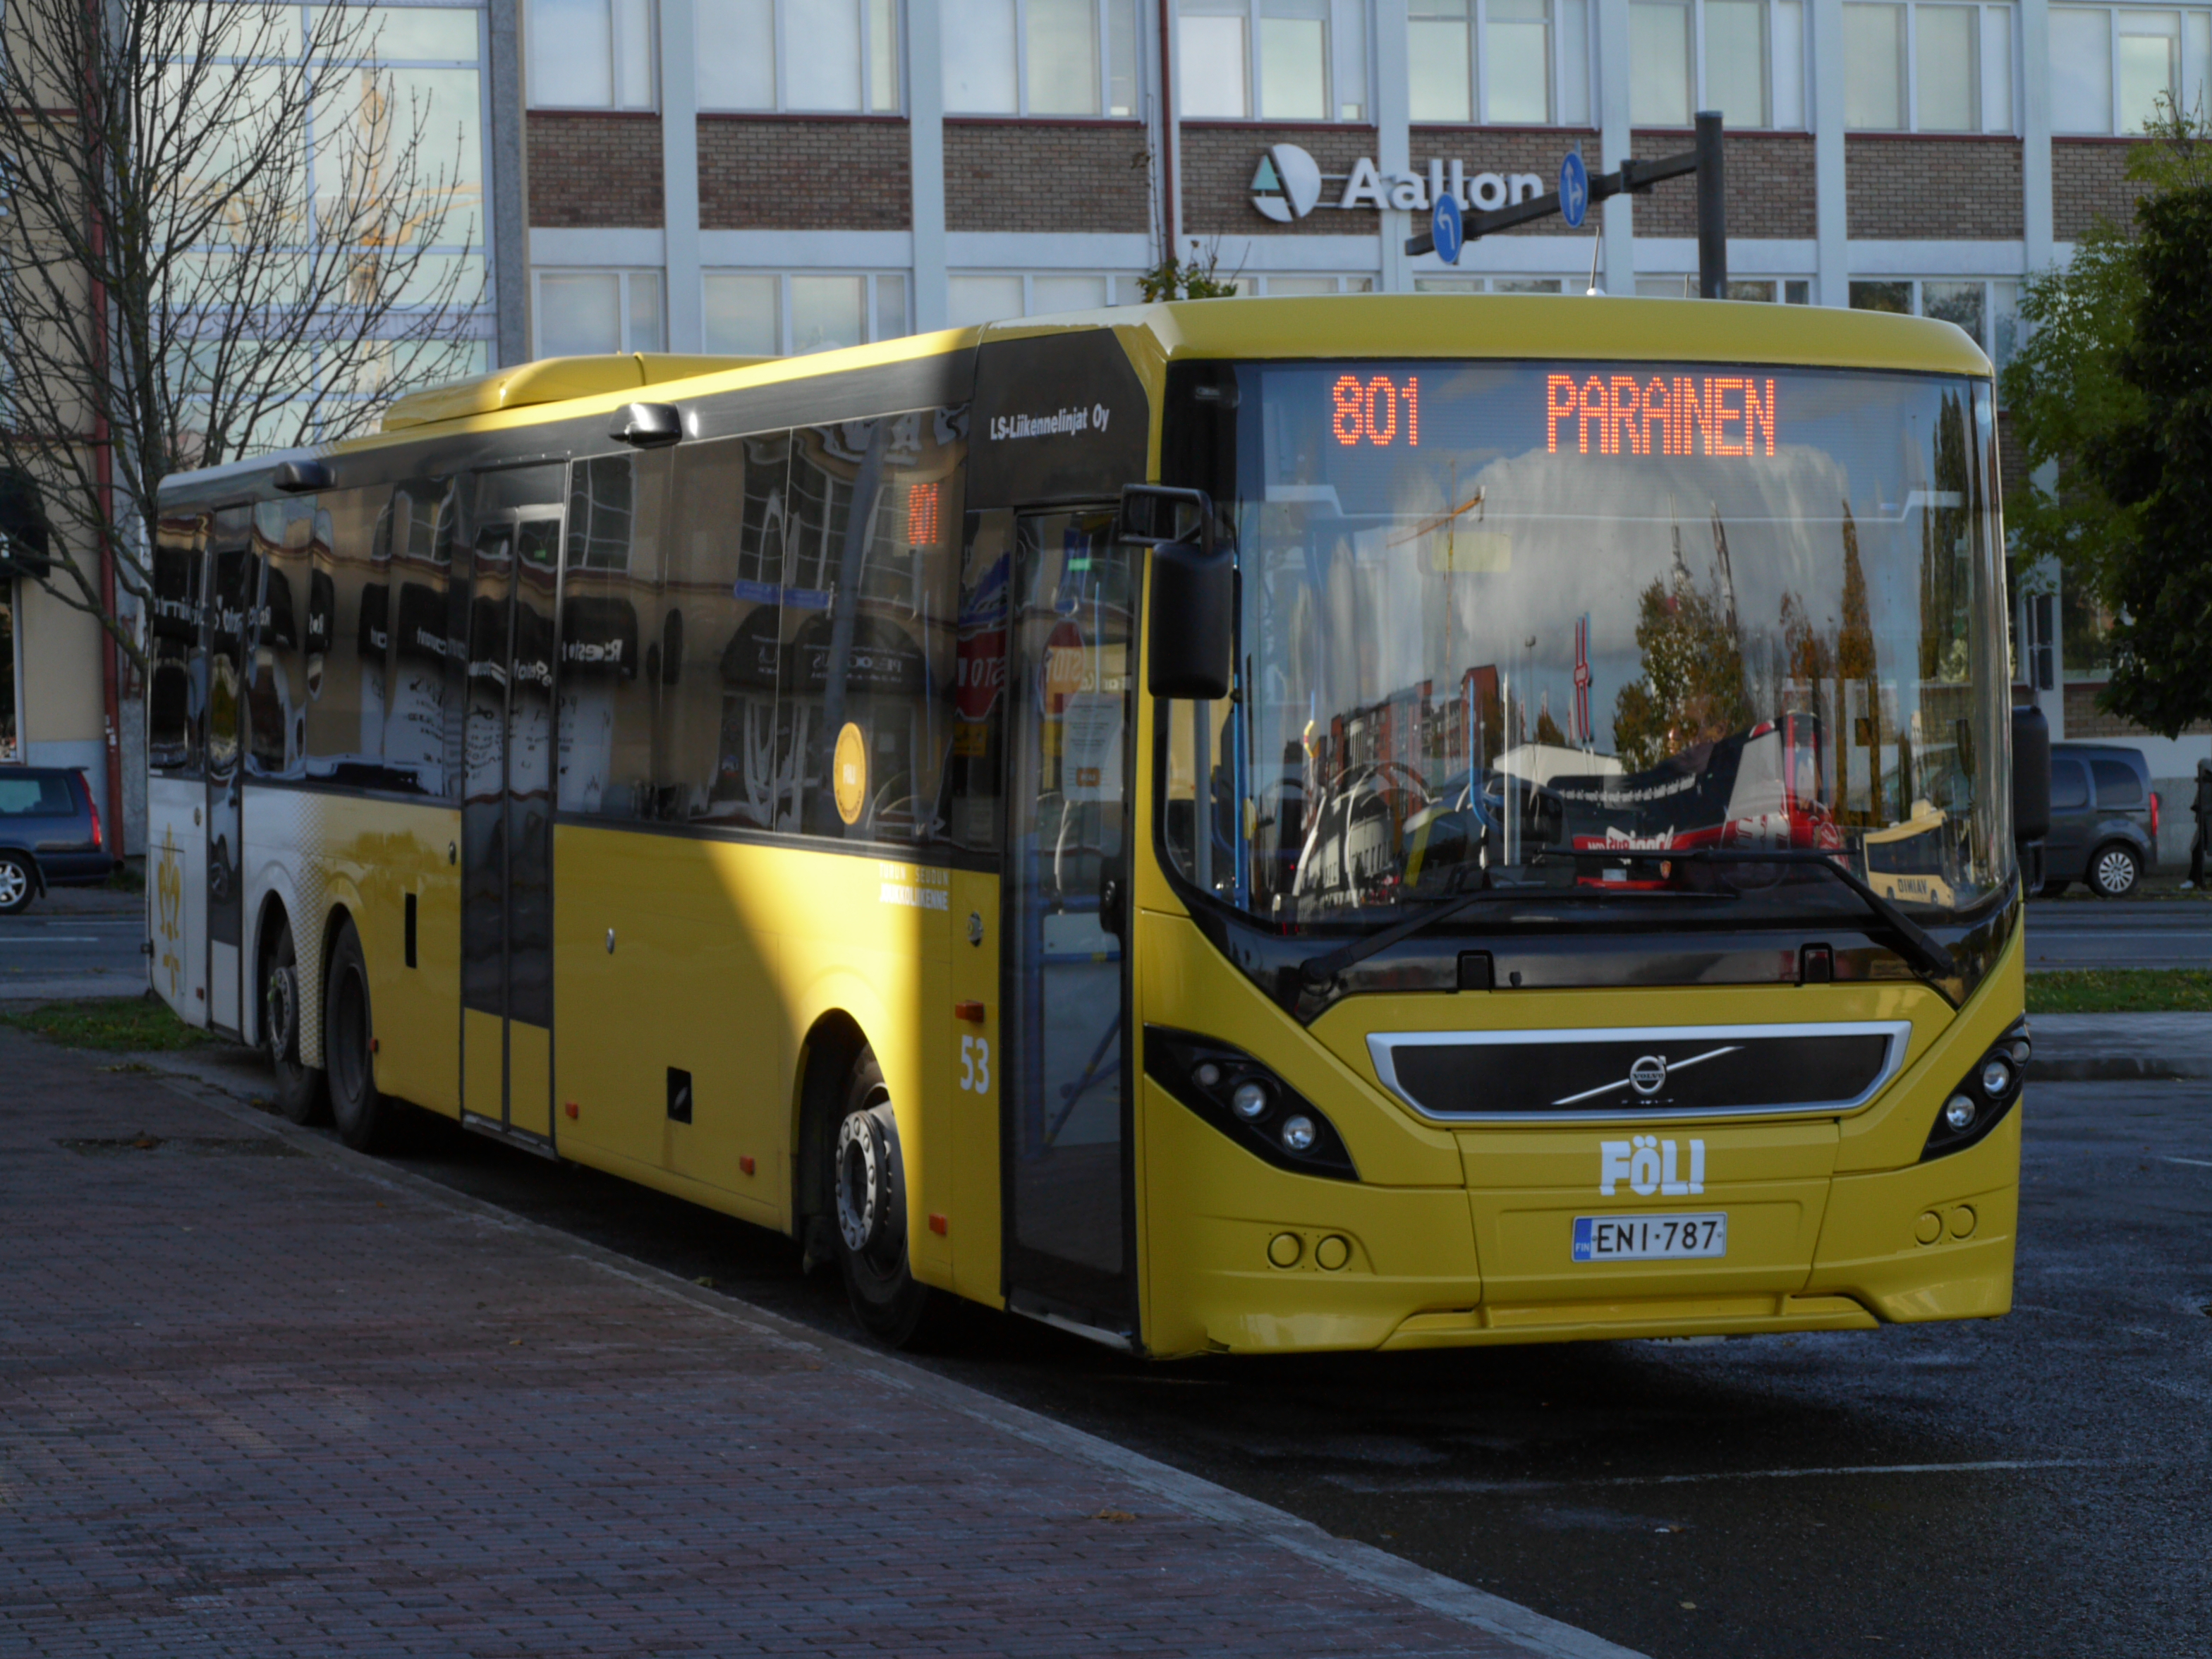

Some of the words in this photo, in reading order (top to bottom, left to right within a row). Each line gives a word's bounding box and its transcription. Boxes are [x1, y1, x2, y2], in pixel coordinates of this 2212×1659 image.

[1340, 157, 1544, 212] Aallon
[990, 406, 1088, 441] LS-Liikennelinjat
[1093, 403, 1110, 432] Oy
[1332, 375, 1418, 446] 801
[1546, 374, 1775, 457] PARAINEN
[907, 482, 939, 545] 801
[879, 882, 949, 911] JOUKKOLIIKENNE
[880, 863, 906, 880] TURUN
[916, 866, 949, 886] SEUDUN
[960, 1034, 990, 1095] 53
[1599, 1135, 1705, 1196] FÖLI
[1575, 1242, 1591, 1253] FIN
[1597, 1221, 1718, 1253] ENI-787
